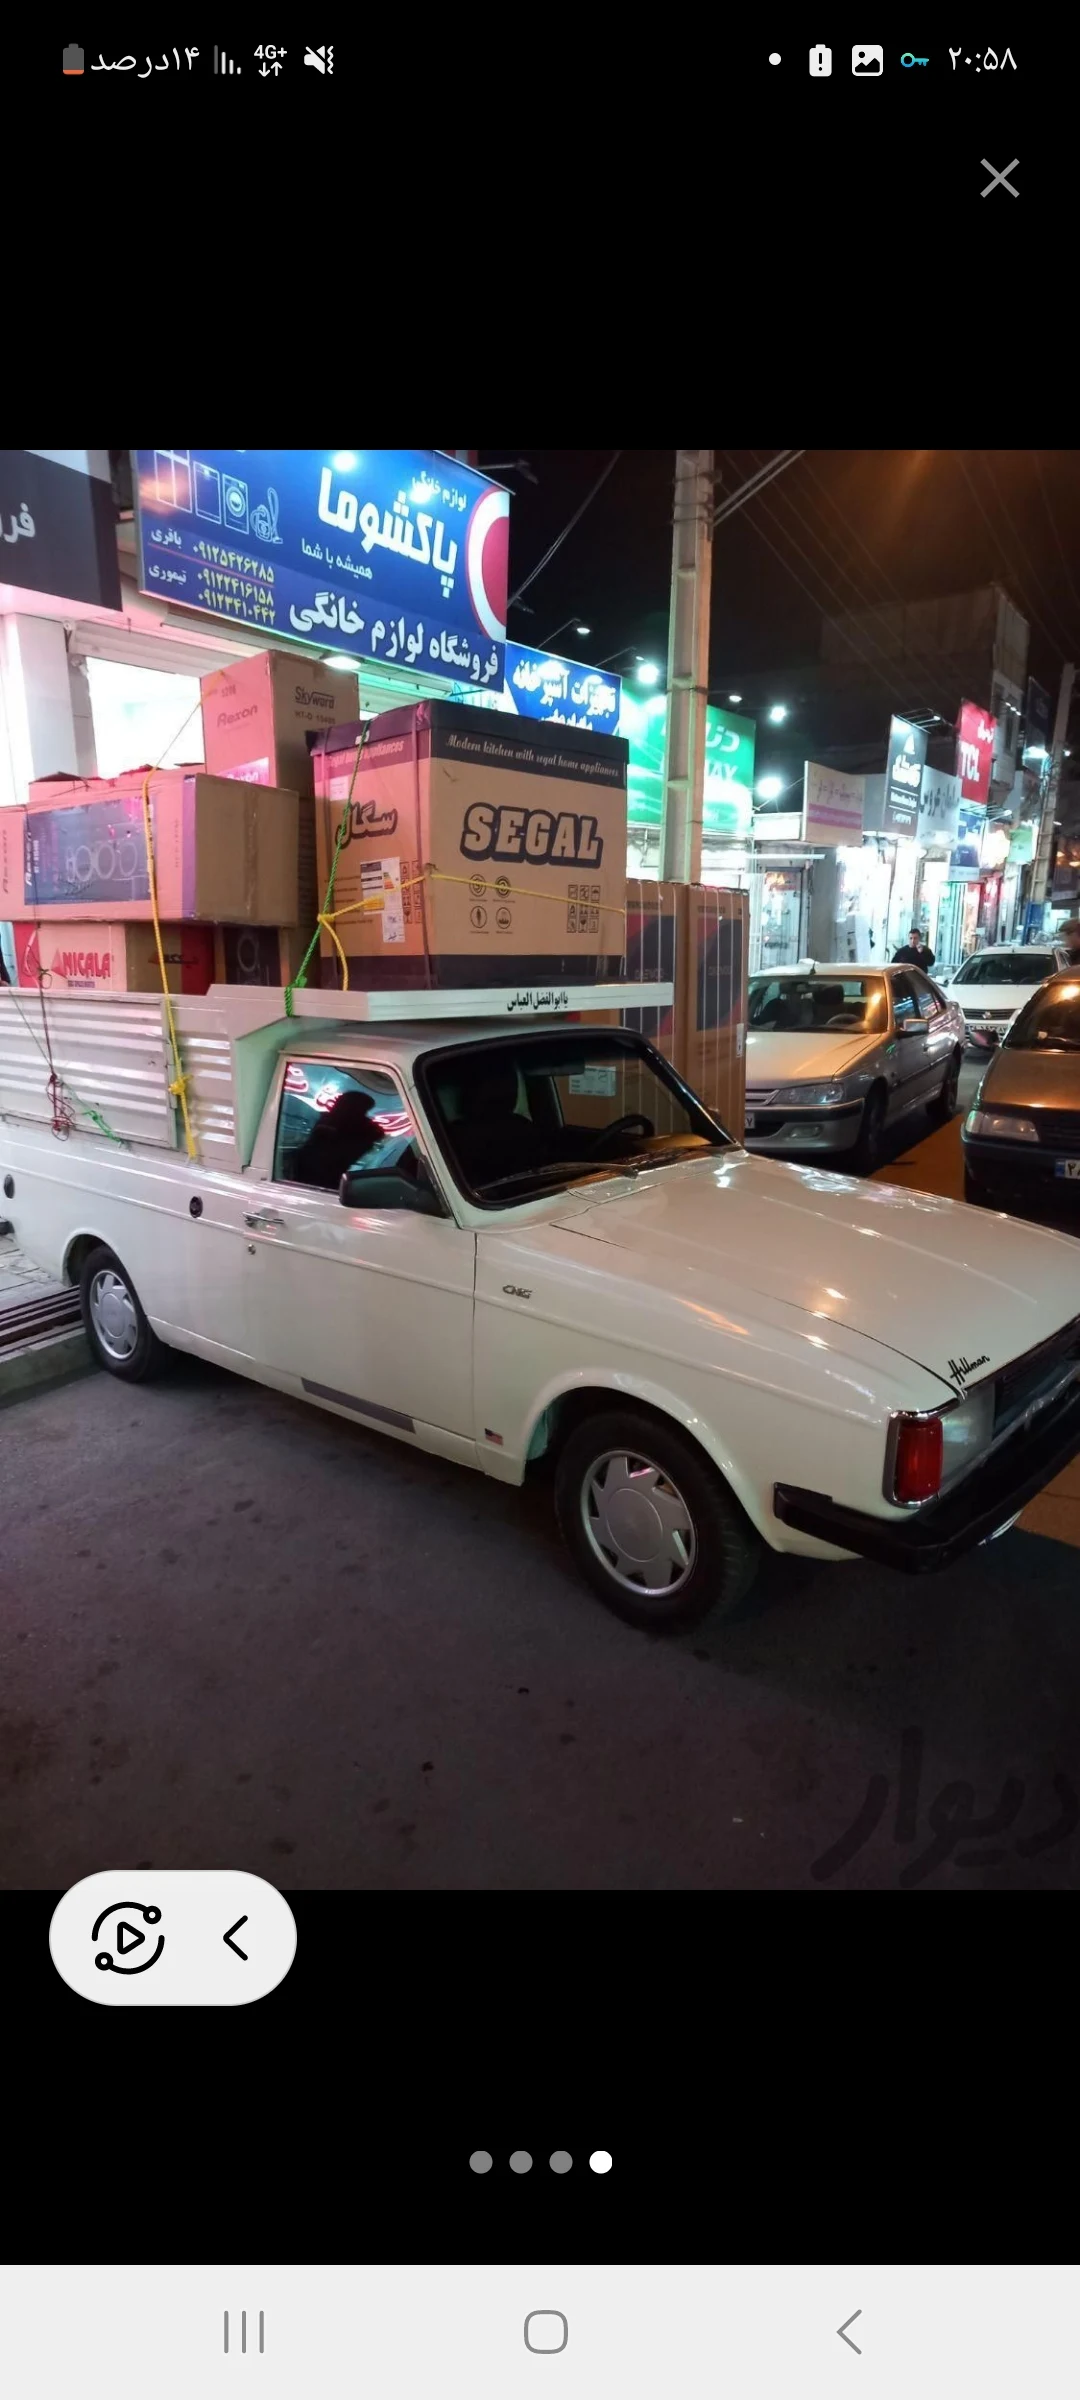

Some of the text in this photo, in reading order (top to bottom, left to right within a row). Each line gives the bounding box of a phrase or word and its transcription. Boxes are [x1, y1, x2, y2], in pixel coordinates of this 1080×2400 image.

[443, 488, 467, 512] لوازم
[151, 528, 182, 549] باقری
[318, 466, 458, 598] پاکشوما
[149, 564, 187, 585] تیموری
[301, 538, 373, 580] همیشه با شما
[289, 591, 499, 684] فروشگاه لوازم خانگی
[446, 734, 481, 751] Modern
[483, 741, 514, 758] kitchen
[515, 748, 534, 761] with
[558, 755, 579, 770] home
[959, 740, 980, 782] TCL
[460, 802, 604, 869] SEGAL
